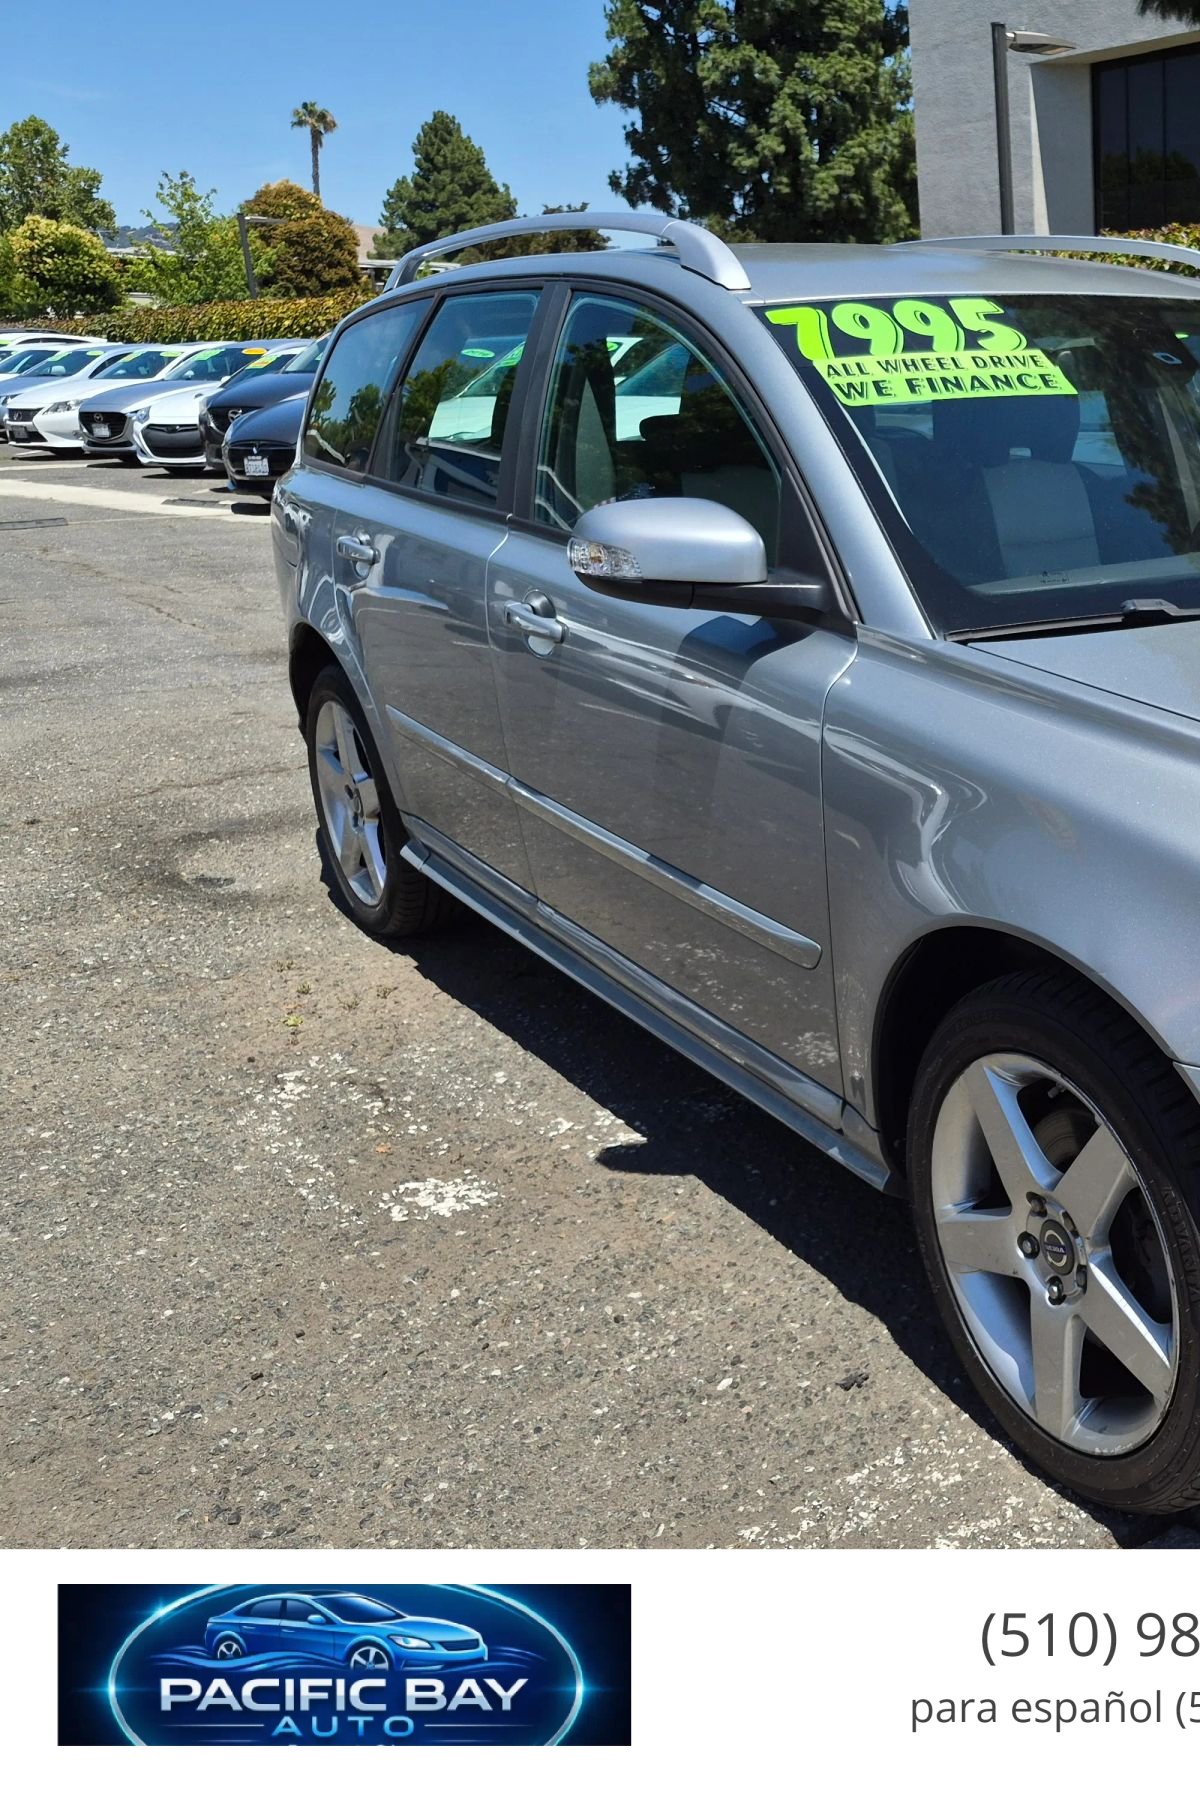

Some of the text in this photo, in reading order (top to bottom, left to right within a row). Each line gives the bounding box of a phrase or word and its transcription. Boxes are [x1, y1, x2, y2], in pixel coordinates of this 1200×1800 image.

[765, 298, 1028, 361] 7995
[826, 353, 1047, 379] ALL WHEEL DRIVE
[834, 372, 1062, 401] WE FINANCE
